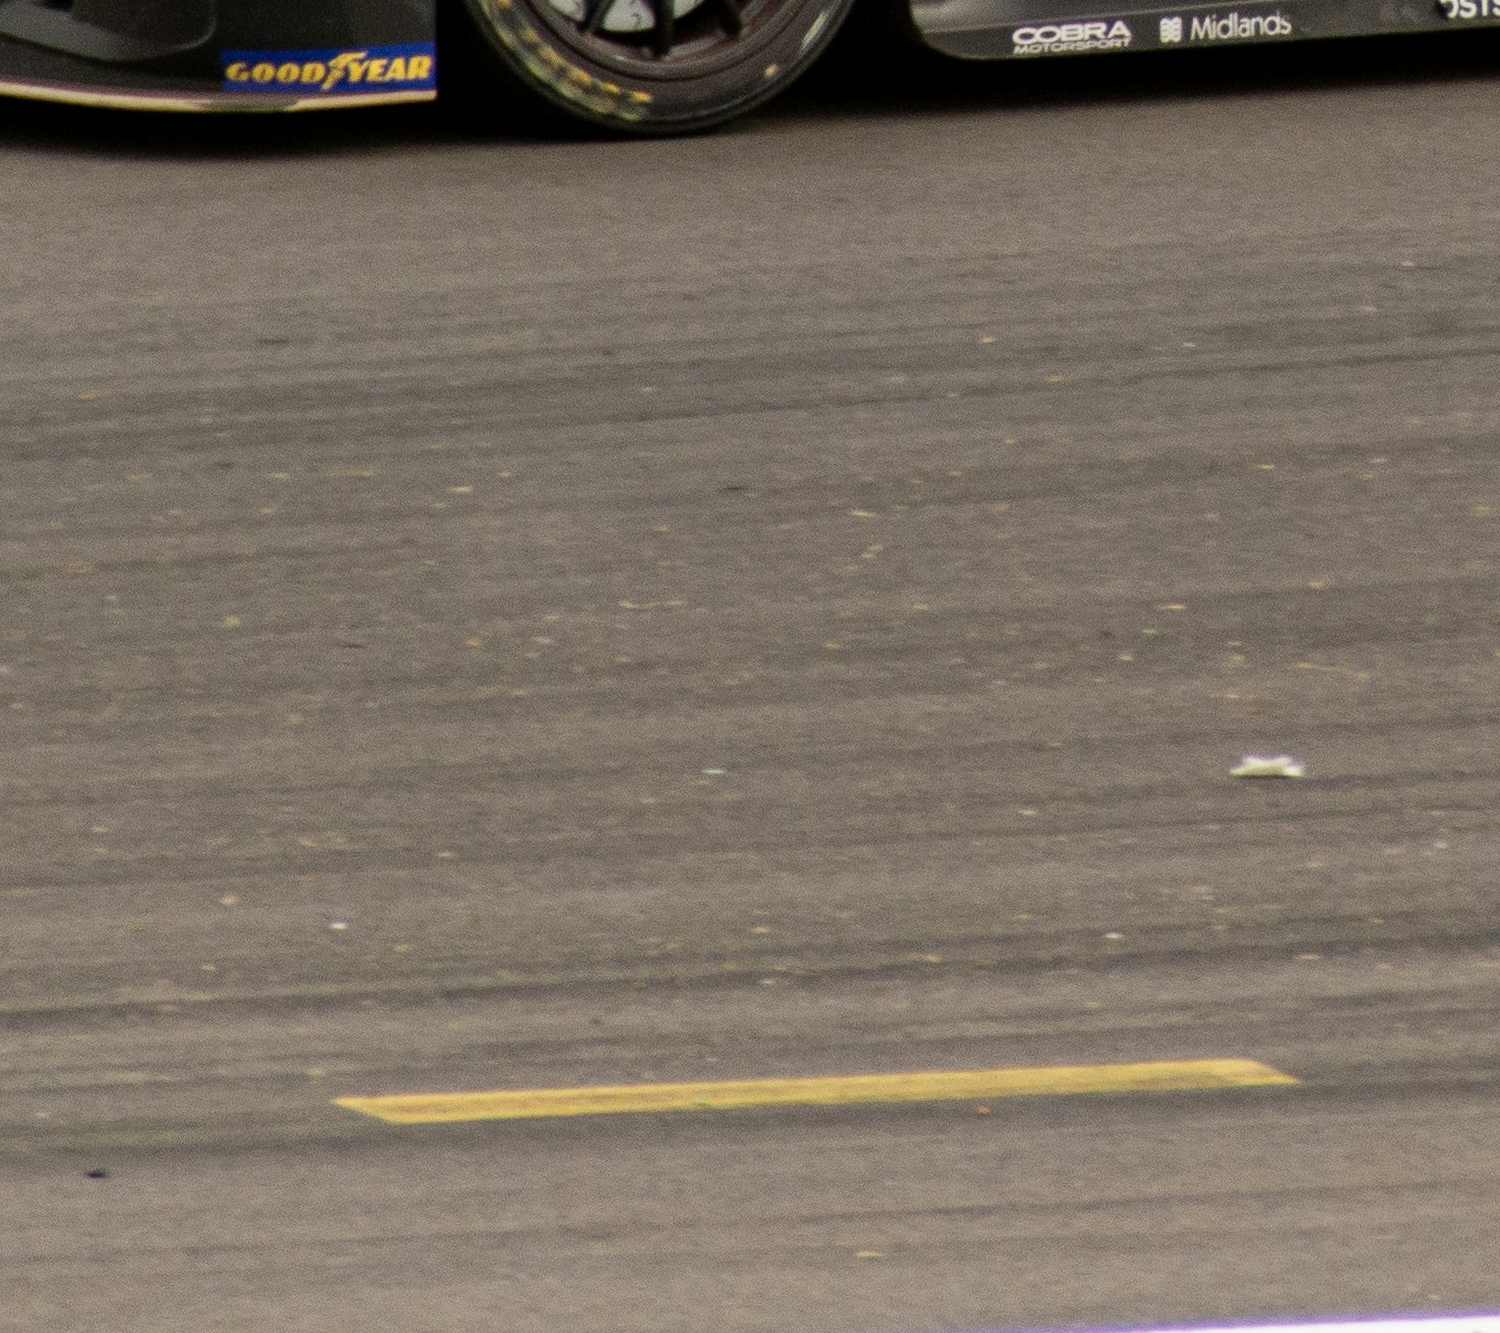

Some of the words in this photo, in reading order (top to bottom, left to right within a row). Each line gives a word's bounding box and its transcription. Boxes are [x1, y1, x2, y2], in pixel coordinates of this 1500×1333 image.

[1012, 20, 1132, 45] COBRA
[1190, 12, 1292, 42] Midlands
[1013, 37, 1132, 54] MOTORSPORT
[226, 51, 432, 92] GOODYEAR
